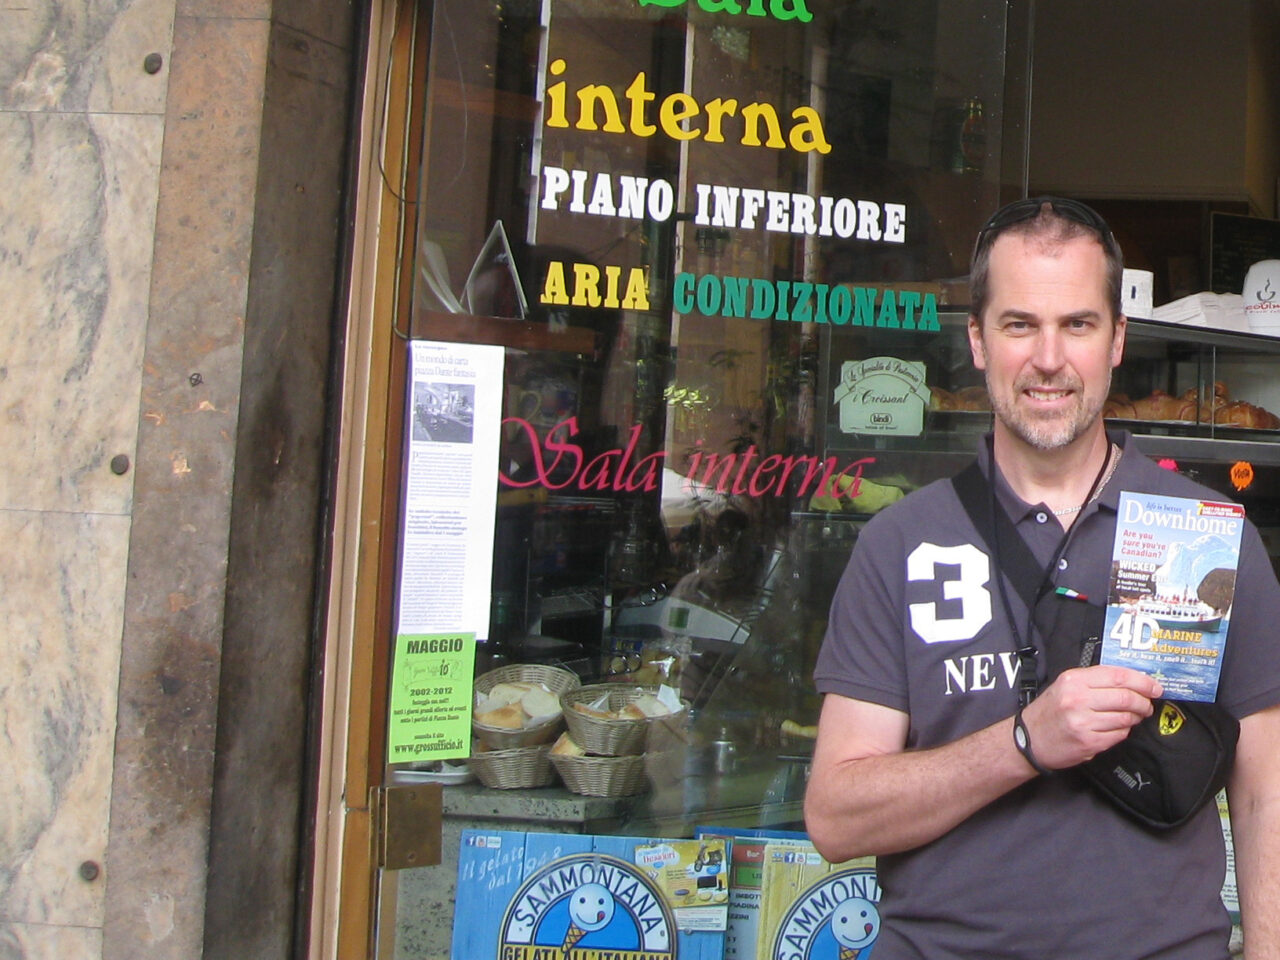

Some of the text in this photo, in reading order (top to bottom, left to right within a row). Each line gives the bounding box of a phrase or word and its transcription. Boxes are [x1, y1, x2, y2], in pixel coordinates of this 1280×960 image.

[544, 58, 832, 155] interna
[541, 166, 907, 244] PIANO INFERIORE
[539, 261, 942, 333] ARIA CONDIZIONATA
[499, 416, 669, 491] Sala
[682, 438, 877, 499] interna
[1124, 499, 1237, 536] Downhome
[1121, 548, 1162, 559] Canadian?
[1142, 542, 1166, 550] you're
[1117, 570, 1150, 581] Summer
[1119, 560, 1156, 572] WICKED
[907, 541, 993, 644] 3
[406, 638, 463, 655] MAGGIO
[1109, 611, 1203, 651] 4D MARINE
[1150, 643, 1218, 658] Adventures
[410, 687, 453, 697] 2002-2012
[1113, 766, 1138, 789] PUMA
[478, 846, 525, 881] gelato
[514, 862, 664, 935] SAMMONTANA
[779, 875, 878, 960] SAMMONT
[503, 945, 670, 960] GELATI ALL'ITA
